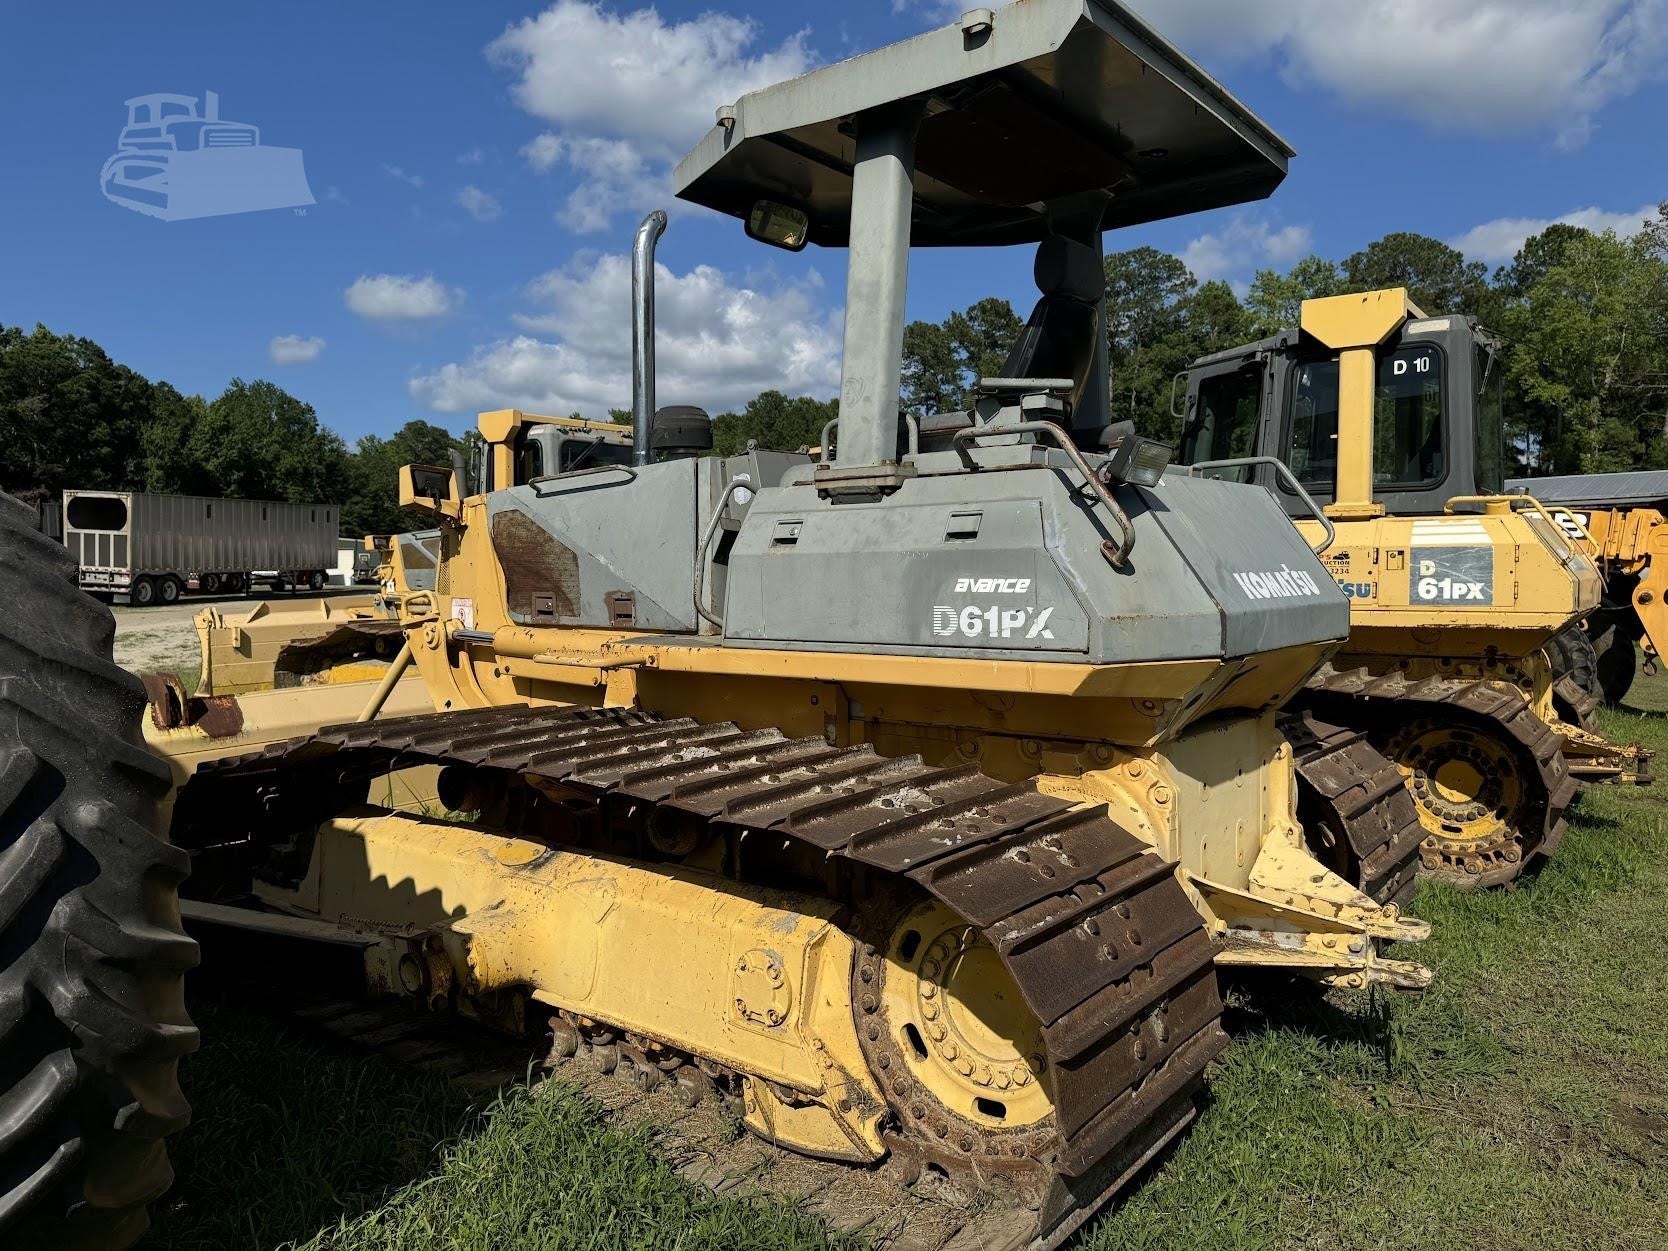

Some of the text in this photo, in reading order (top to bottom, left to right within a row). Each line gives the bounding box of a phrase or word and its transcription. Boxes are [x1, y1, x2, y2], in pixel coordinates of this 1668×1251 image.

[1393, 356, 1430, 375] D 10
[1419, 559, 1436, 576] D
[953, 578, 1031, 593] avance
[1232, 563, 1321, 599] KOMATSU
[1417, 577, 1486, 600] 61PX
[933, 605, 1055, 639] D61PX
